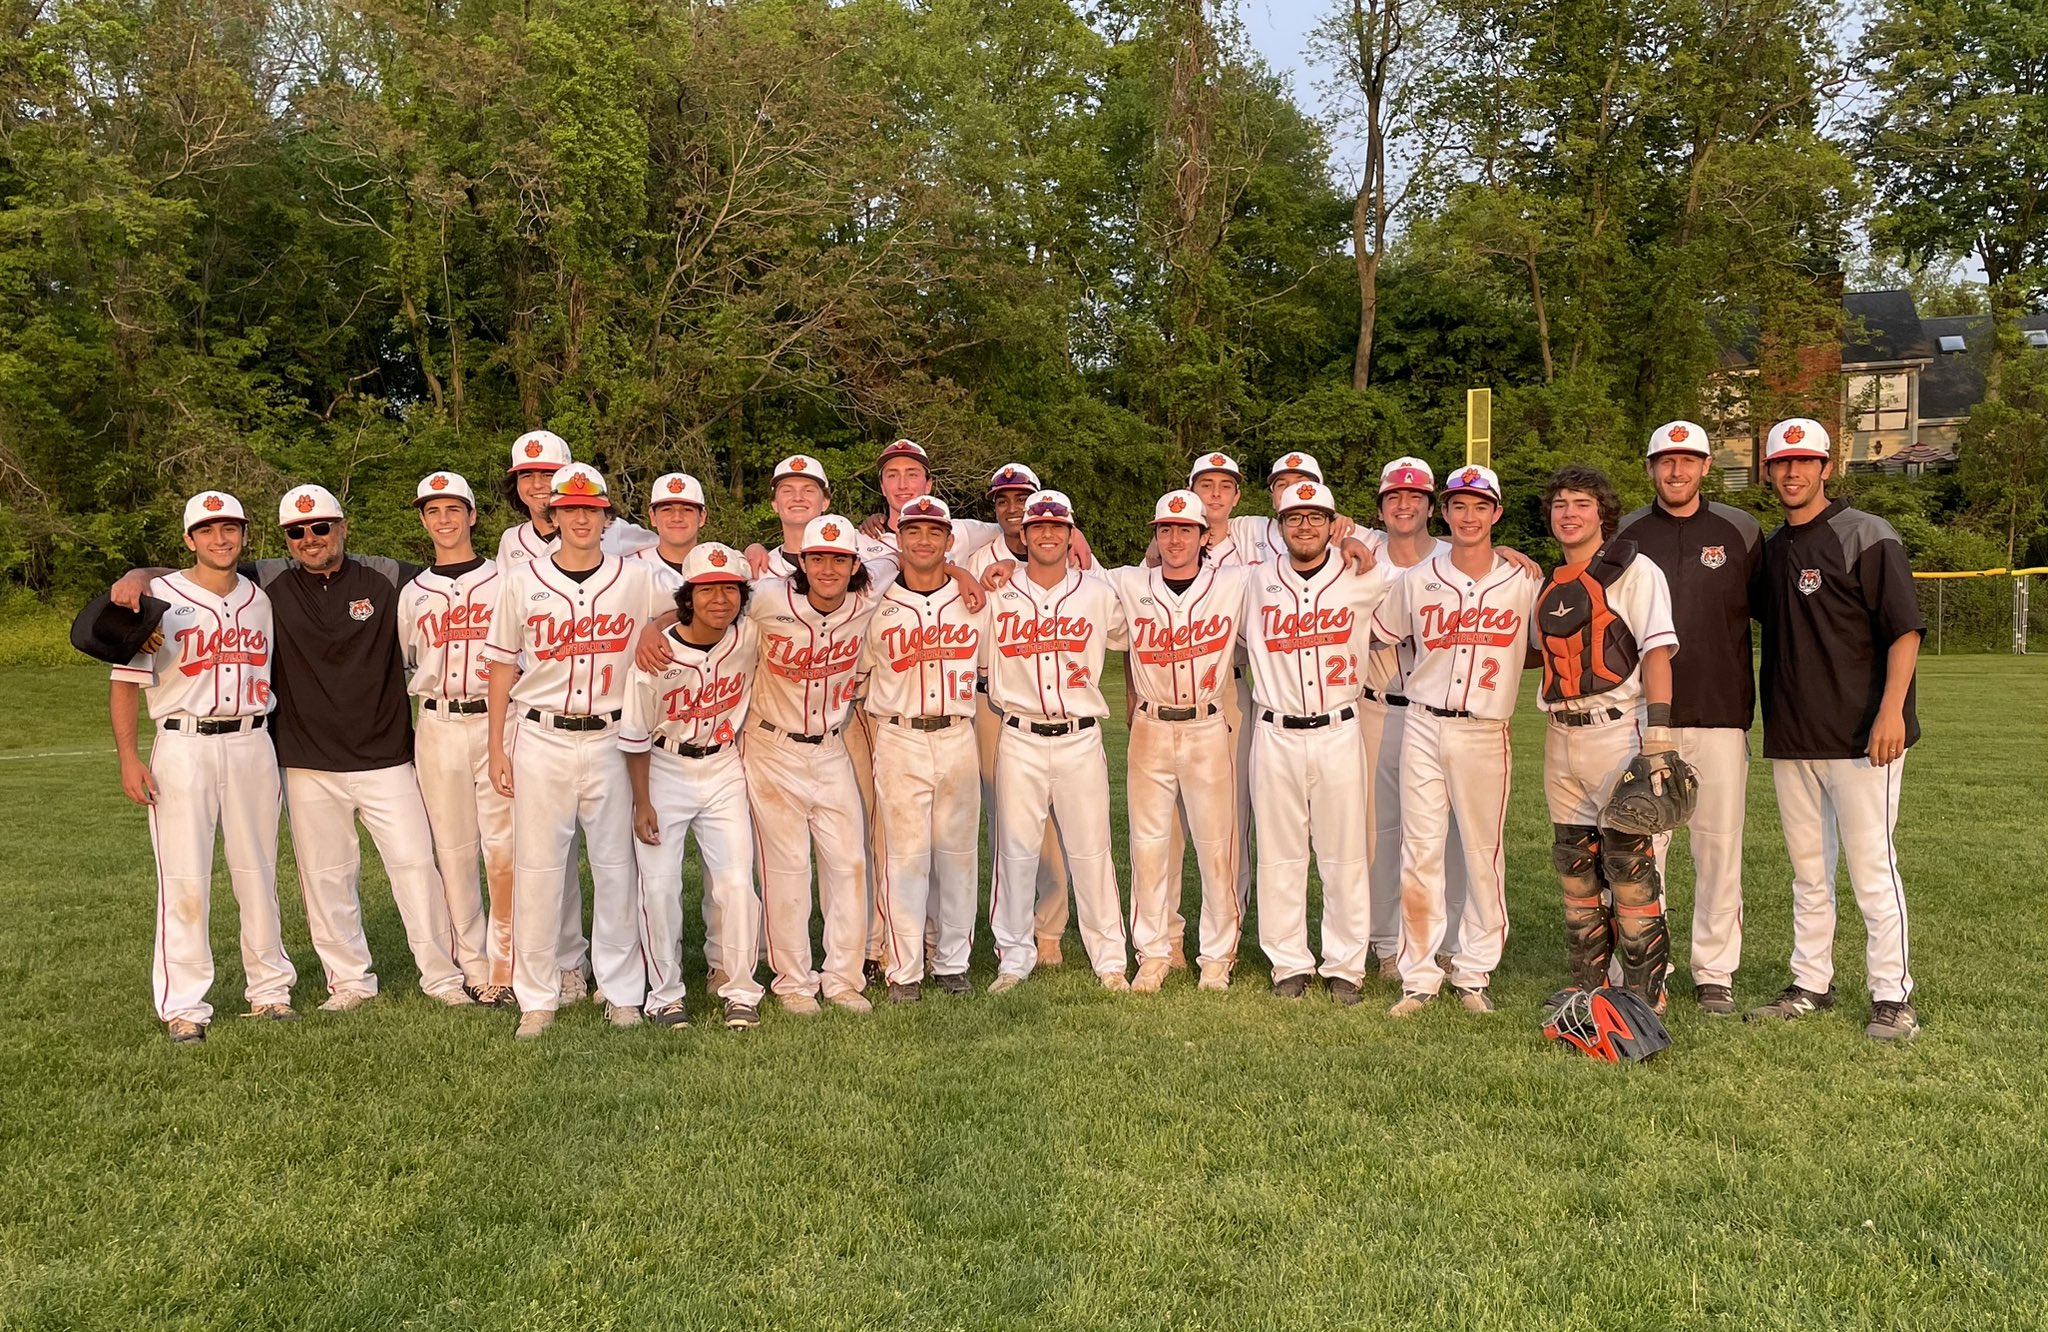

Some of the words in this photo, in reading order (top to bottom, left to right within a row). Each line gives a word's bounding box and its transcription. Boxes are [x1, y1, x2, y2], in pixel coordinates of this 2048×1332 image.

[417, 609, 494, 648] Tier
[527, 612, 635, 648] Tigers
[997, 610, 1093, 643] Tigers
[1134, 614, 1232, 649] Tigers
[1261, 604, 1355, 638] Tigers
[1420, 602, 1521, 638] Tigers
[175, 625, 267, 663] Tigers
[766, 634, 862, 665] Tigers
[881, 624, 979, 660] Tigers
[601, 664, 613, 696] 1
[948, 670, 975, 700] 13
[1066, 661, 1091, 689] 2
[1200, 663, 1218, 692] 4
[1477, 657, 1500, 691] 2
